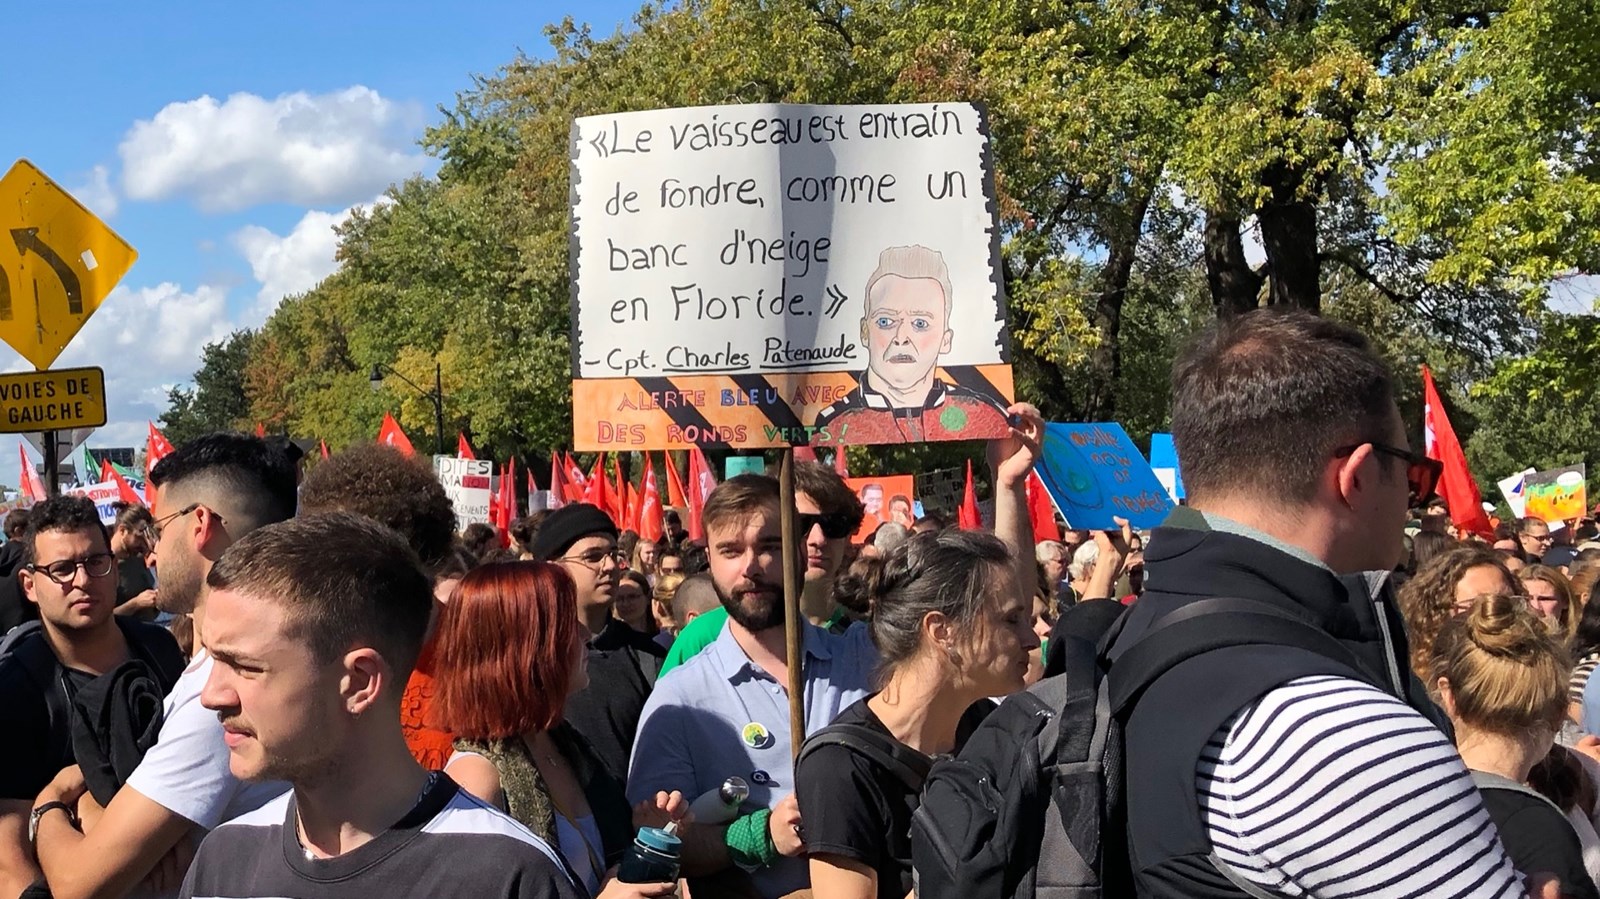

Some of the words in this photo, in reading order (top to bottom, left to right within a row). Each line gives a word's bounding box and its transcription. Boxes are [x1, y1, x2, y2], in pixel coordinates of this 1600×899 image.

[669, 114, 802, 151] vaisseau
[808, 114, 849, 143] est
[859, 105, 963, 139] entrain
[605, 181, 641, 216] de
[660, 174, 764, 209] fondre,
[786, 174, 897, 204] comme
[927, 171, 967, 200] un
[607, 238, 688, 271] banc
[720, 229, 831, 277] d'neige
[610, 297, 648, 323] en
[671, 277, 812, 321] Floride.
[665, 341, 750, 368] Charles
[763, 333, 857, 364] Patenaude
[0, 380, 56, 401] VOIES
[66, 377, 90, 396] DE
[617, 389, 706, 412] ALERTE
[720, 387, 779, 407] BLEU
[791, 384, 846, 406] AVEC
[8, 401, 84, 424] GAUCHE
[597, 420, 646, 444] DES
[667, 422, 747, 443] RONDS
[762, 423, 848, 444] VERTS!
[441, 458, 490, 475] DITES
